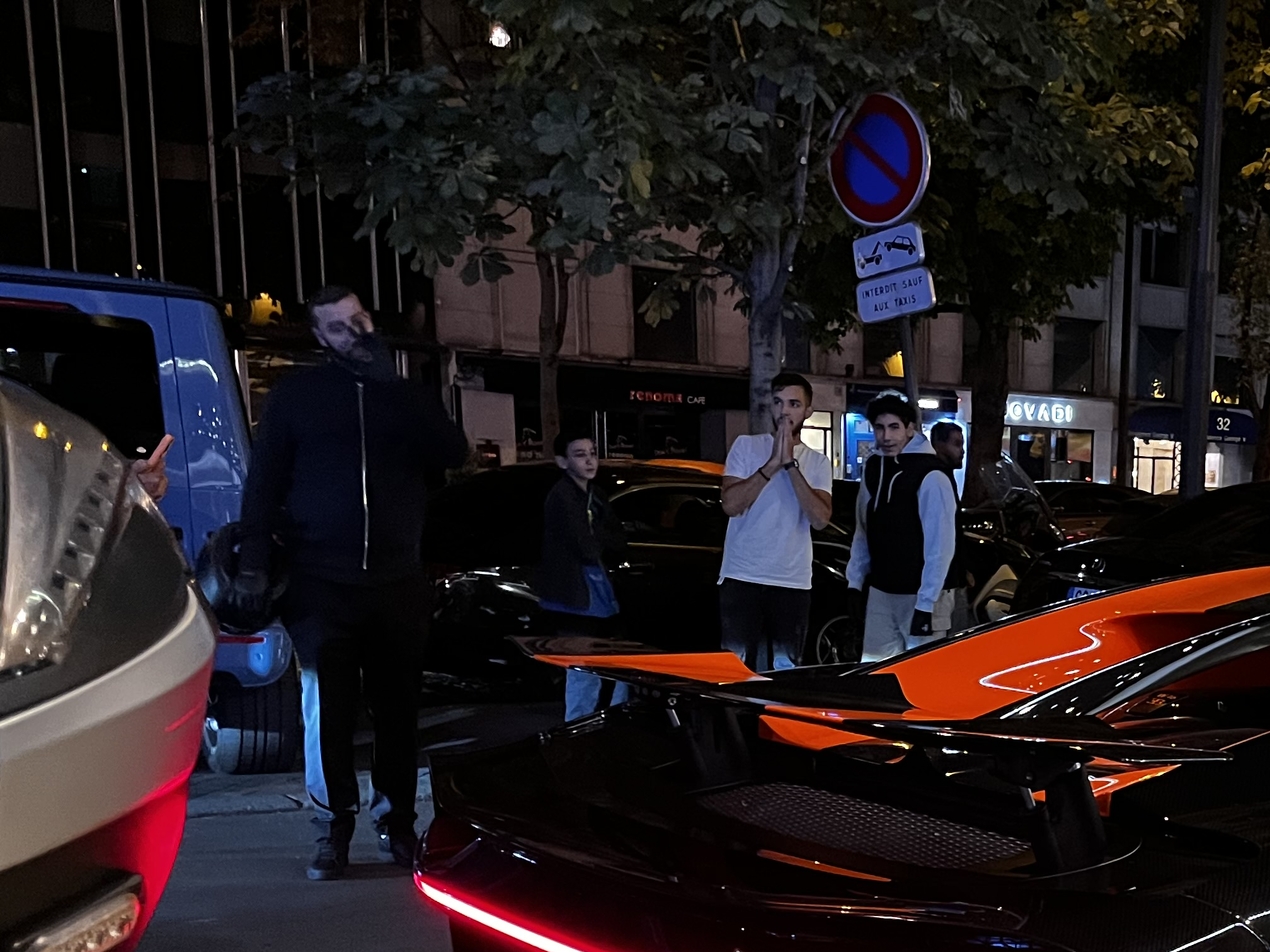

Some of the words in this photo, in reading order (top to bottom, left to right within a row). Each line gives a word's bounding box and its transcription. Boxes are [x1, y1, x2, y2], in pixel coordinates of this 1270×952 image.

[862, 283, 897, 299] INTERDIT
[902, 276, 923, 289] SAUF
[874, 302, 889, 312] AUX
[894, 295, 916, 307] TAXIS
[1005, 401, 1073, 423] OVADI
[1216, 417, 1231, 431] 32
